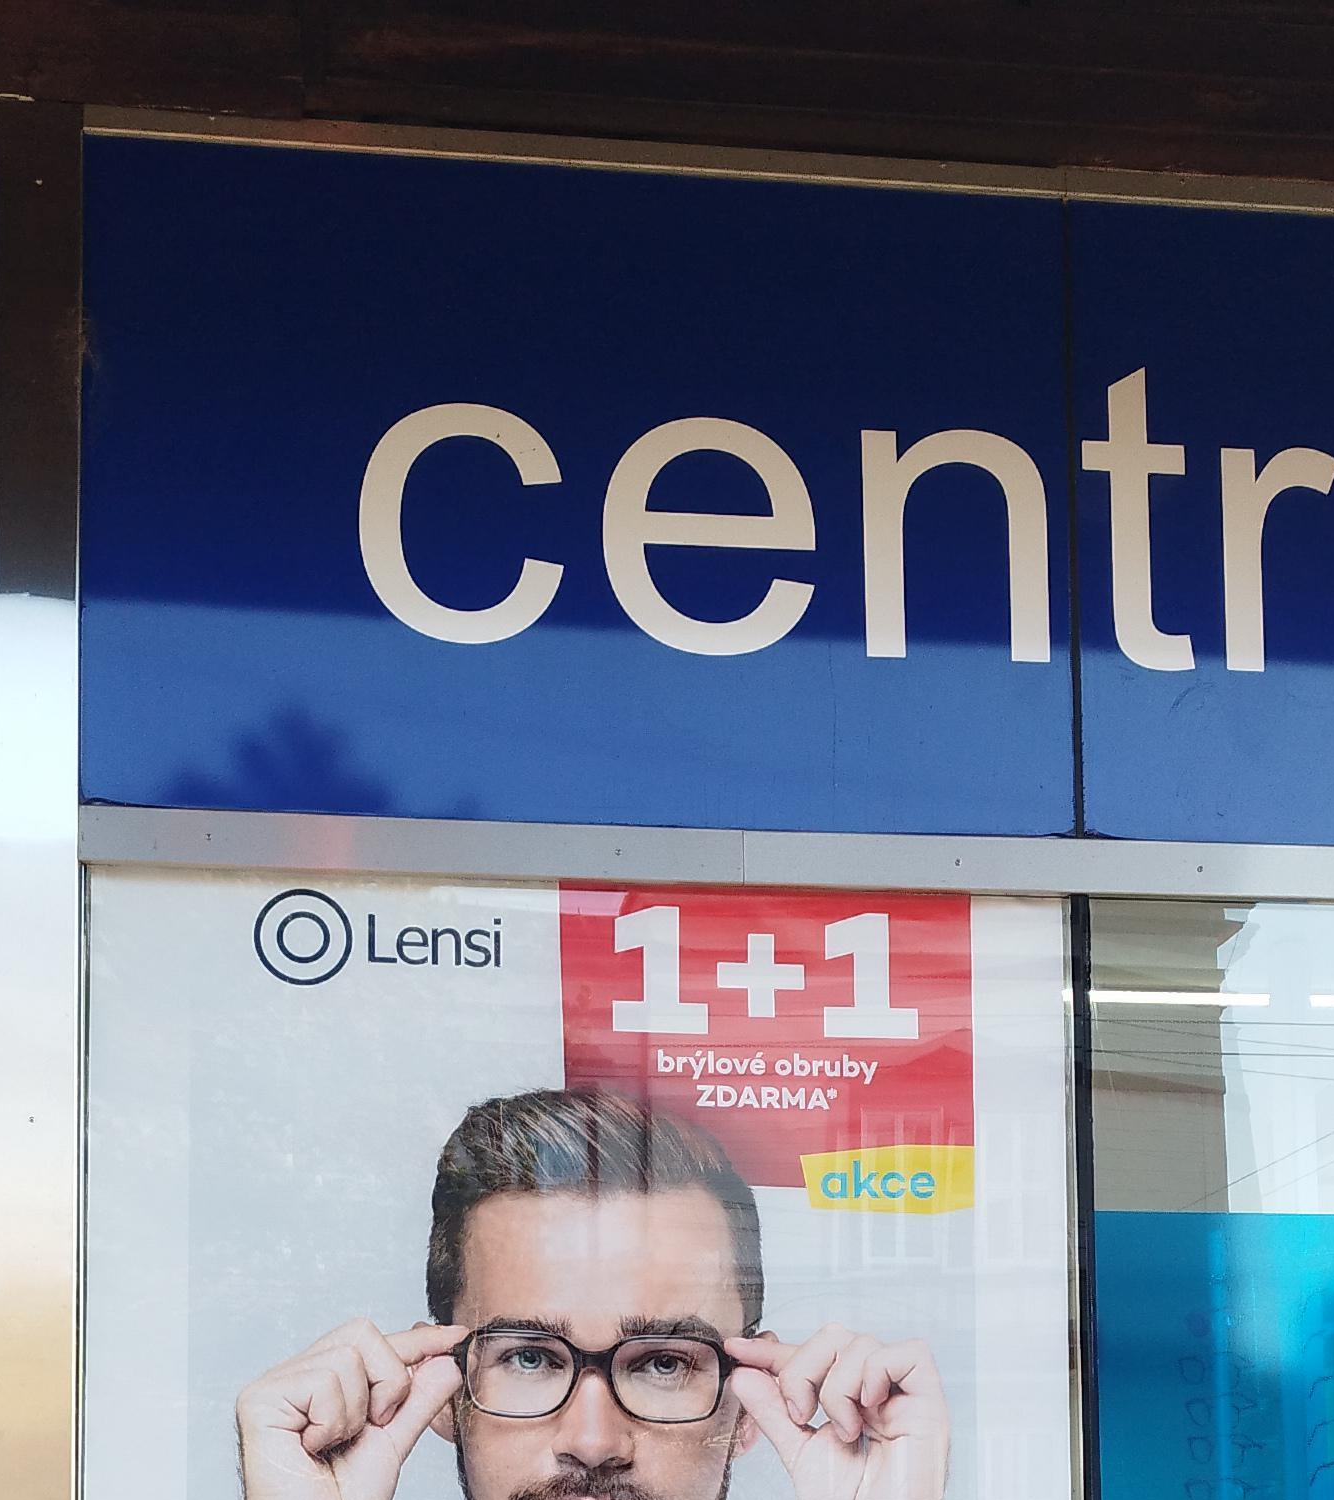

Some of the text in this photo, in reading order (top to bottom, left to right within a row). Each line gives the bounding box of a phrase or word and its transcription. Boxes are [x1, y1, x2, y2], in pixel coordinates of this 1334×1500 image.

[367, 913, 501, 967] Lensi
[613, 905, 920, 1040] 1+1
[657, 1049, 879, 1085] brýlové obruby
[820, 1160, 936, 1200] akce
